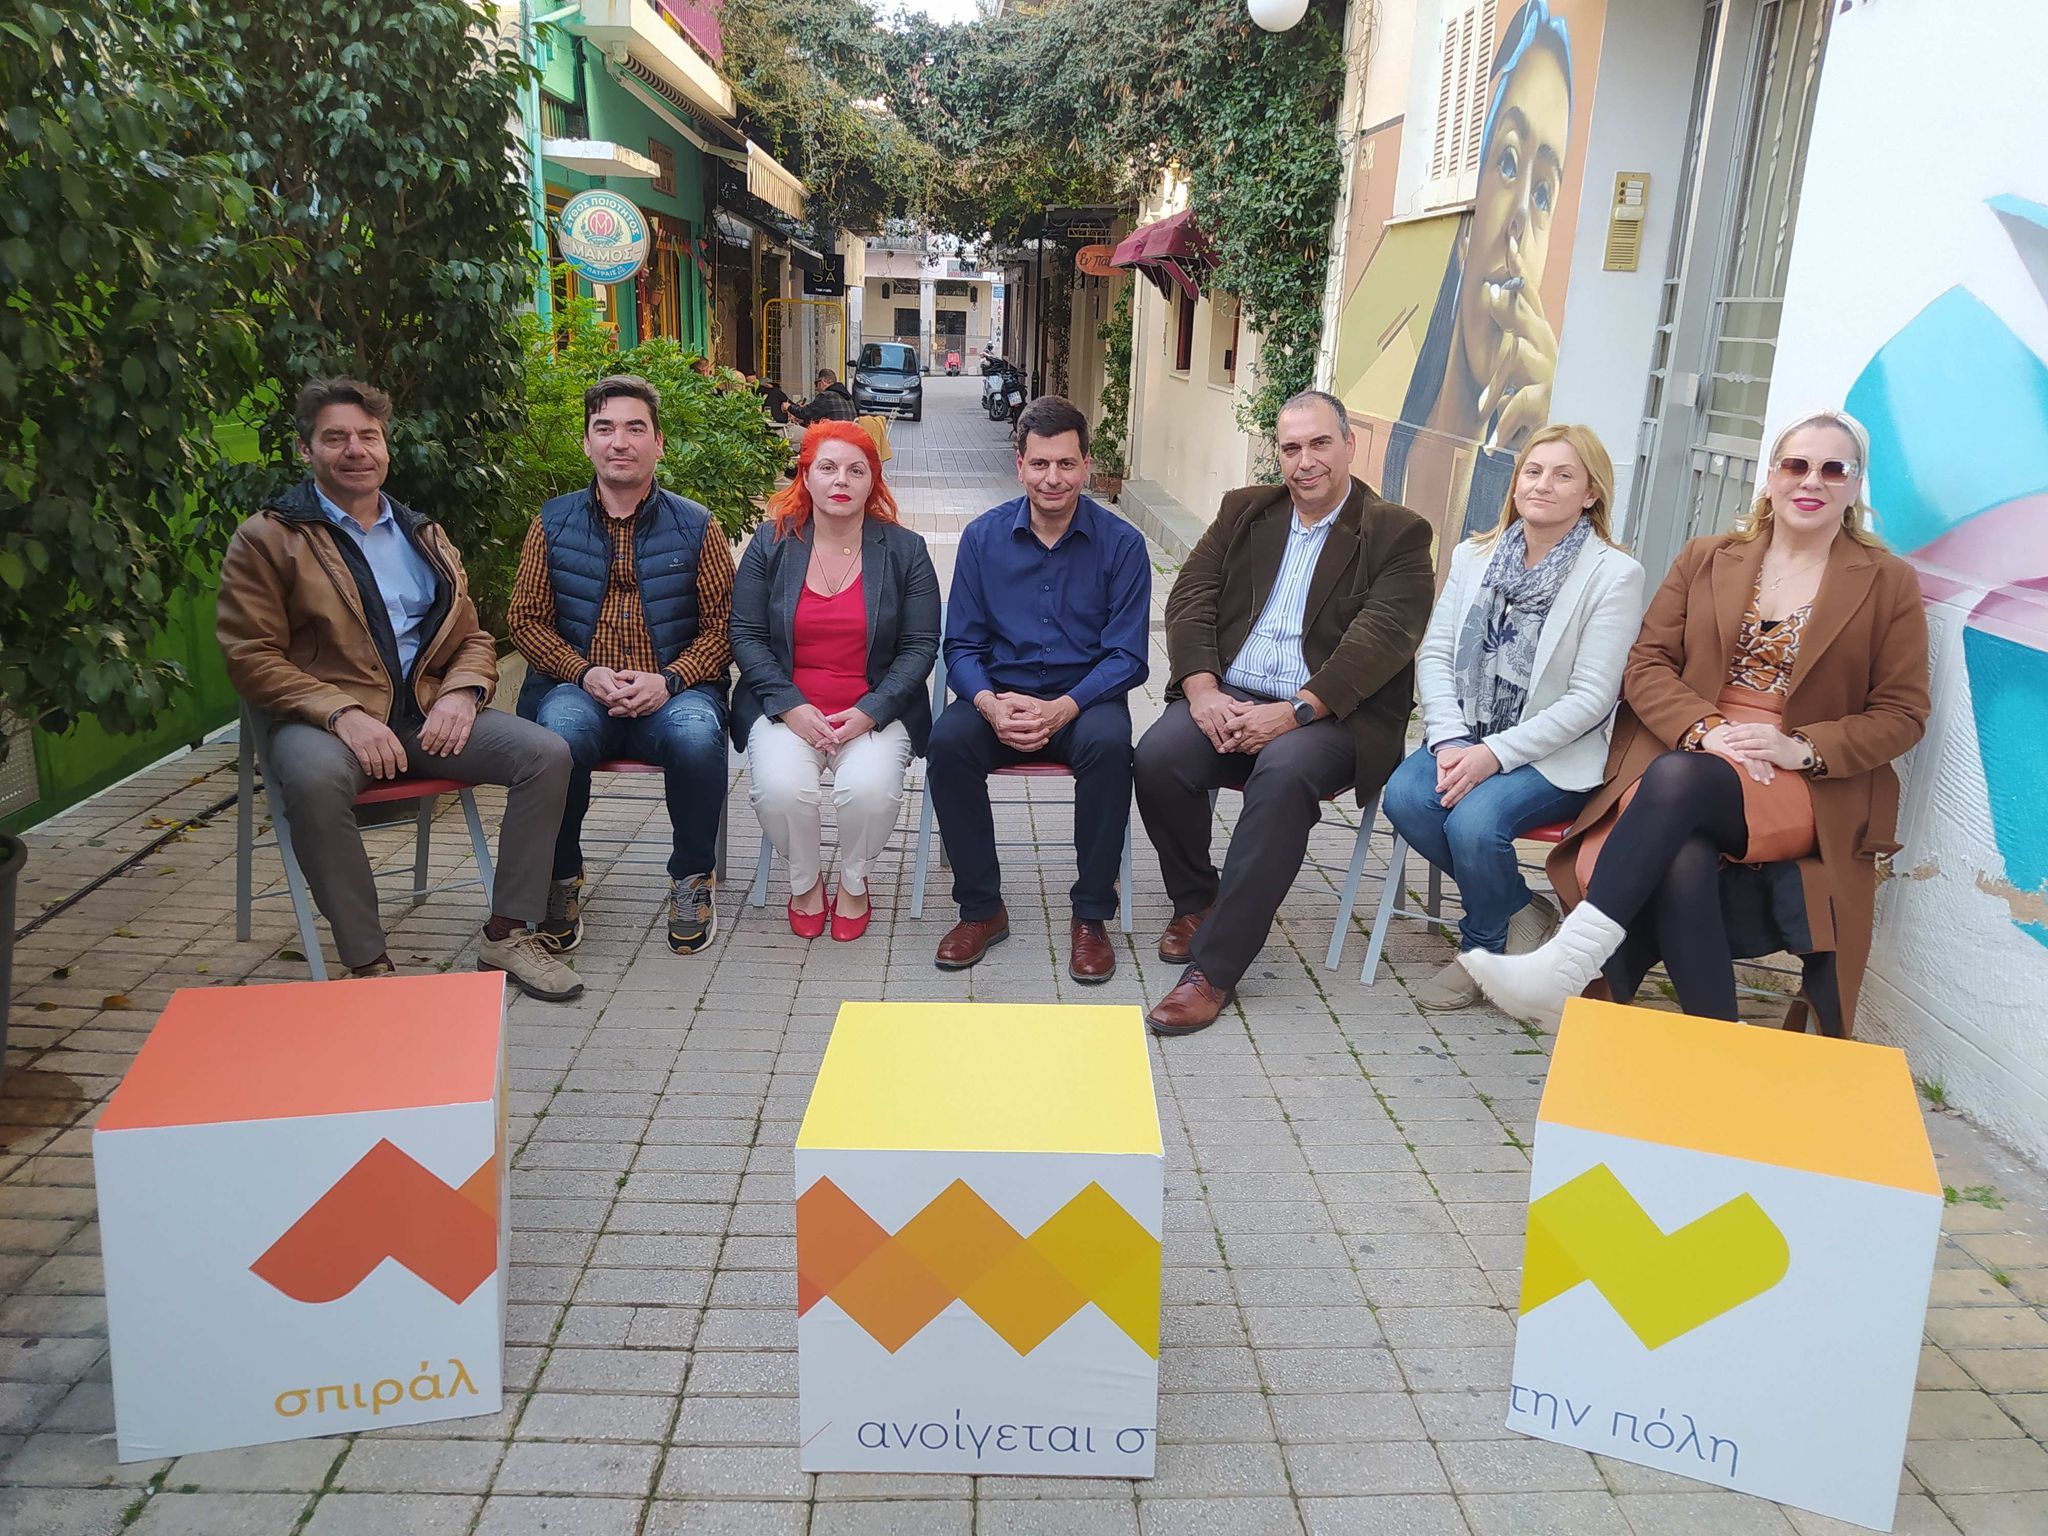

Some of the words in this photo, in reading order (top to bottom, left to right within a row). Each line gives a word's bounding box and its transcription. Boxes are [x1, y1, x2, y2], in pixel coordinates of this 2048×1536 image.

[565, 200, 590, 229] ΖΥΘΟΣ
[591, 197, 640, 236] ΠΟΙΟΤΗΤΟΣ
[572, 240, 634, 263] ΜΑΜΟΣ
[274, 1359, 479, 1418] σπιράλ
[857, 1408, 1096, 1459] ανοίγεται
[1511, 1384, 1592, 1430] την
[1611, 1407, 1739, 1478] πόλη
